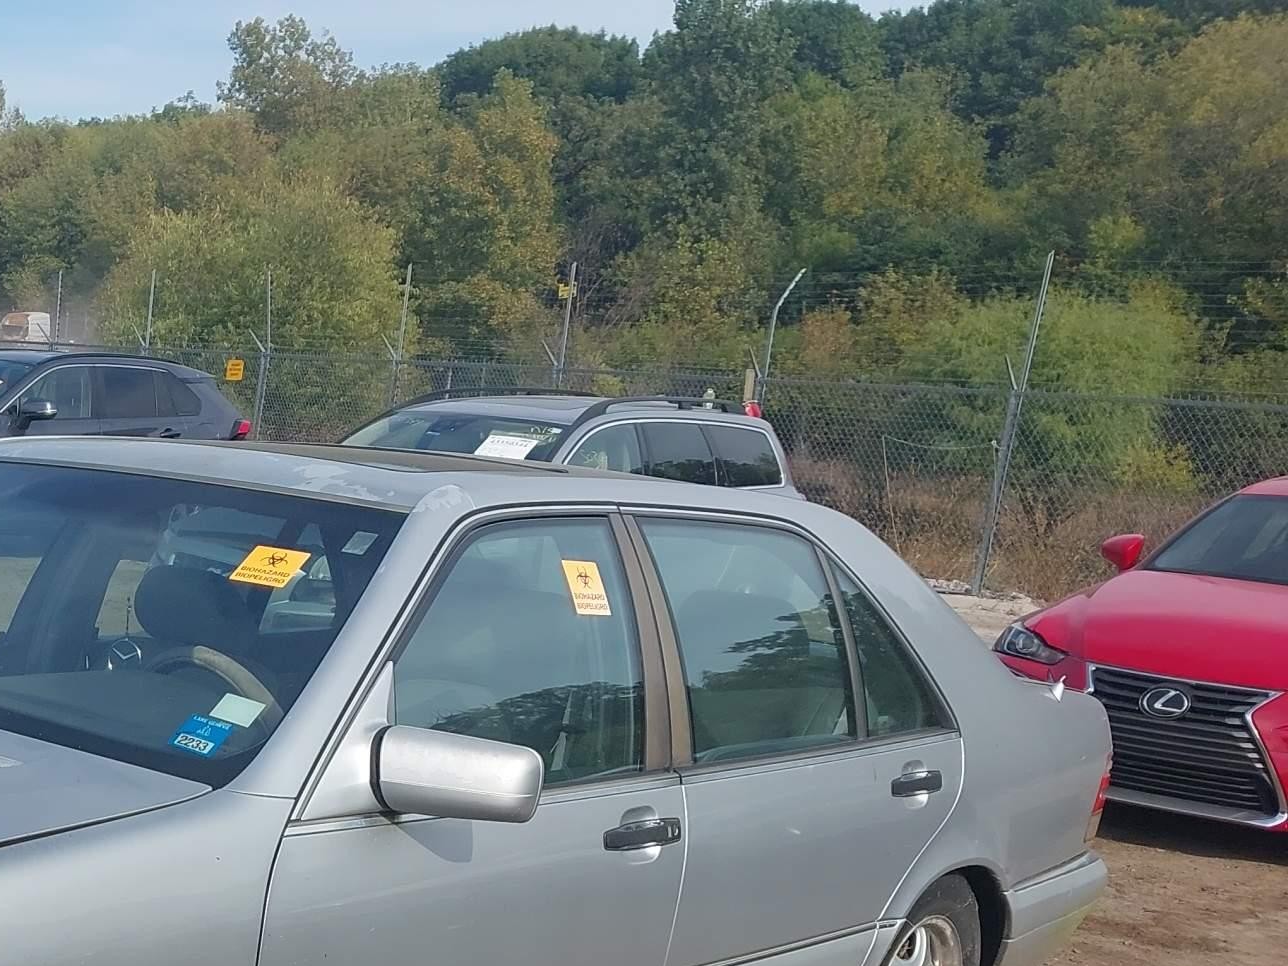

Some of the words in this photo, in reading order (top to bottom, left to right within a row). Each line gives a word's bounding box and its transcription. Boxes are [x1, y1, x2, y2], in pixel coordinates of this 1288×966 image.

[235, 572, 285, 584] BIOPELIGRO
[241, 566, 290, 578] BIOHAZARD
[178, 735, 209, 751] 2233
